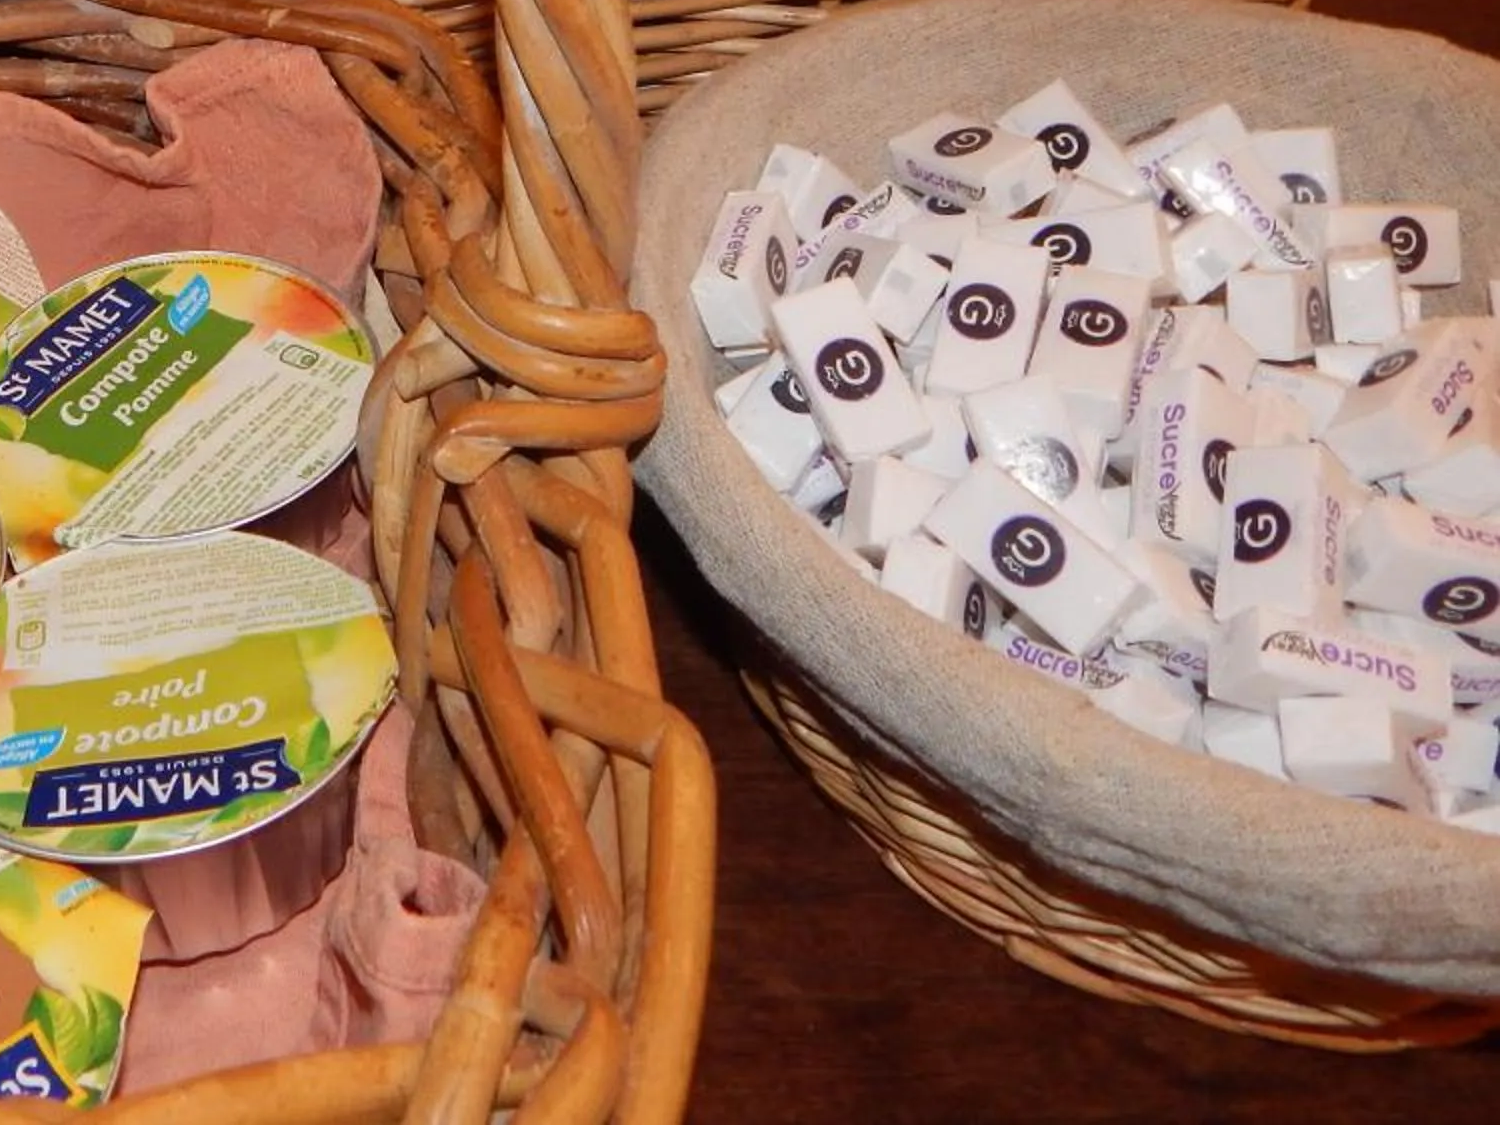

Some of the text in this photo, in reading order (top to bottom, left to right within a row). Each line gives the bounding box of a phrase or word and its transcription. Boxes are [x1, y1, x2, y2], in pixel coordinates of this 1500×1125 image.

[1047, 131, 1079, 160] G
[731, 204, 763, 257] Sucre
[1392, 226, 1418, 255] G
[960, 294, 993, 326] G
[1080, 310, 1116, 339] G
[25, 287, 134, 376] MAMET
[51, 349, 93, 383] DEPUIS
[60, 325, 170, 427] Compote
[837, 349, 870, 384] G
[112, 347, 198, 427] Pomme
[1431, 360, 1474, 415] Sucre
[1158, 403, 1186, 491] Sucre
[1010, 526, 1052, 568] G
[1242, 513, 1278, 549] G
[1323, 495, 1342, 586] Sucre
[1443, 585, 1485, 610] G
[1006, 637, 1079, 678] Sucre
[1321, 641, 1417, 692] Sucre
[112, 670, 208, 708] Poire
[74, 696, 267, 755] Compote
[155, 754, 226, 773] DEPUIS
[47, 759, 278, 819] St MAMET
